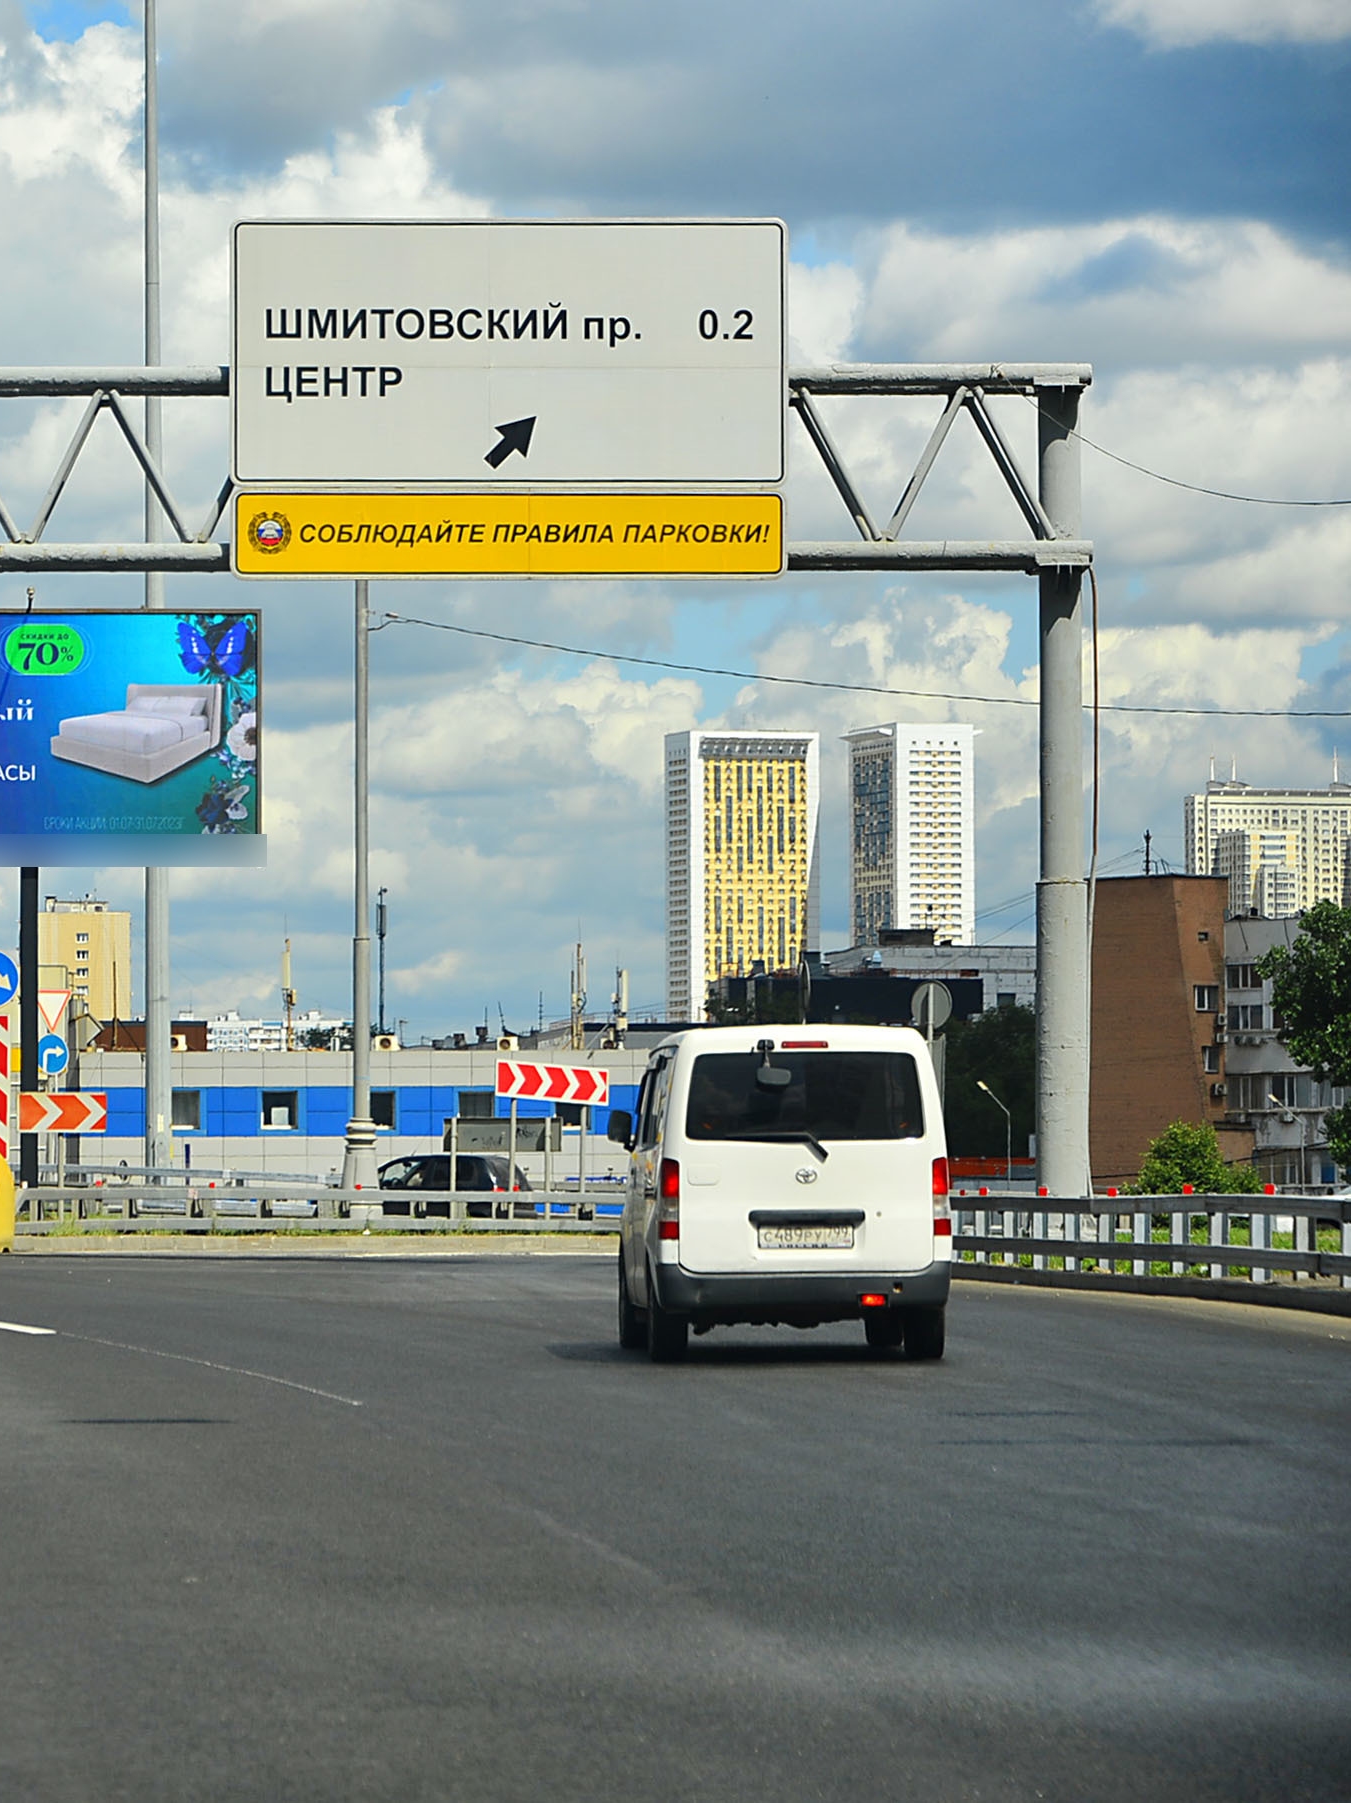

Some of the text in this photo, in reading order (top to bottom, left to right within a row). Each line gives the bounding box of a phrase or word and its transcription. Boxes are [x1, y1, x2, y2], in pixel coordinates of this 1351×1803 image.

[265, 301, 754, 347] ШМИТОВСКИЙ пр. 0.2
[265, 366, 403, 403] ЦЕНТР
[299, 519, 770, 547] СОБЛЮДАЙТЕ ПРАВИЛА ПАРКОВКИ!
